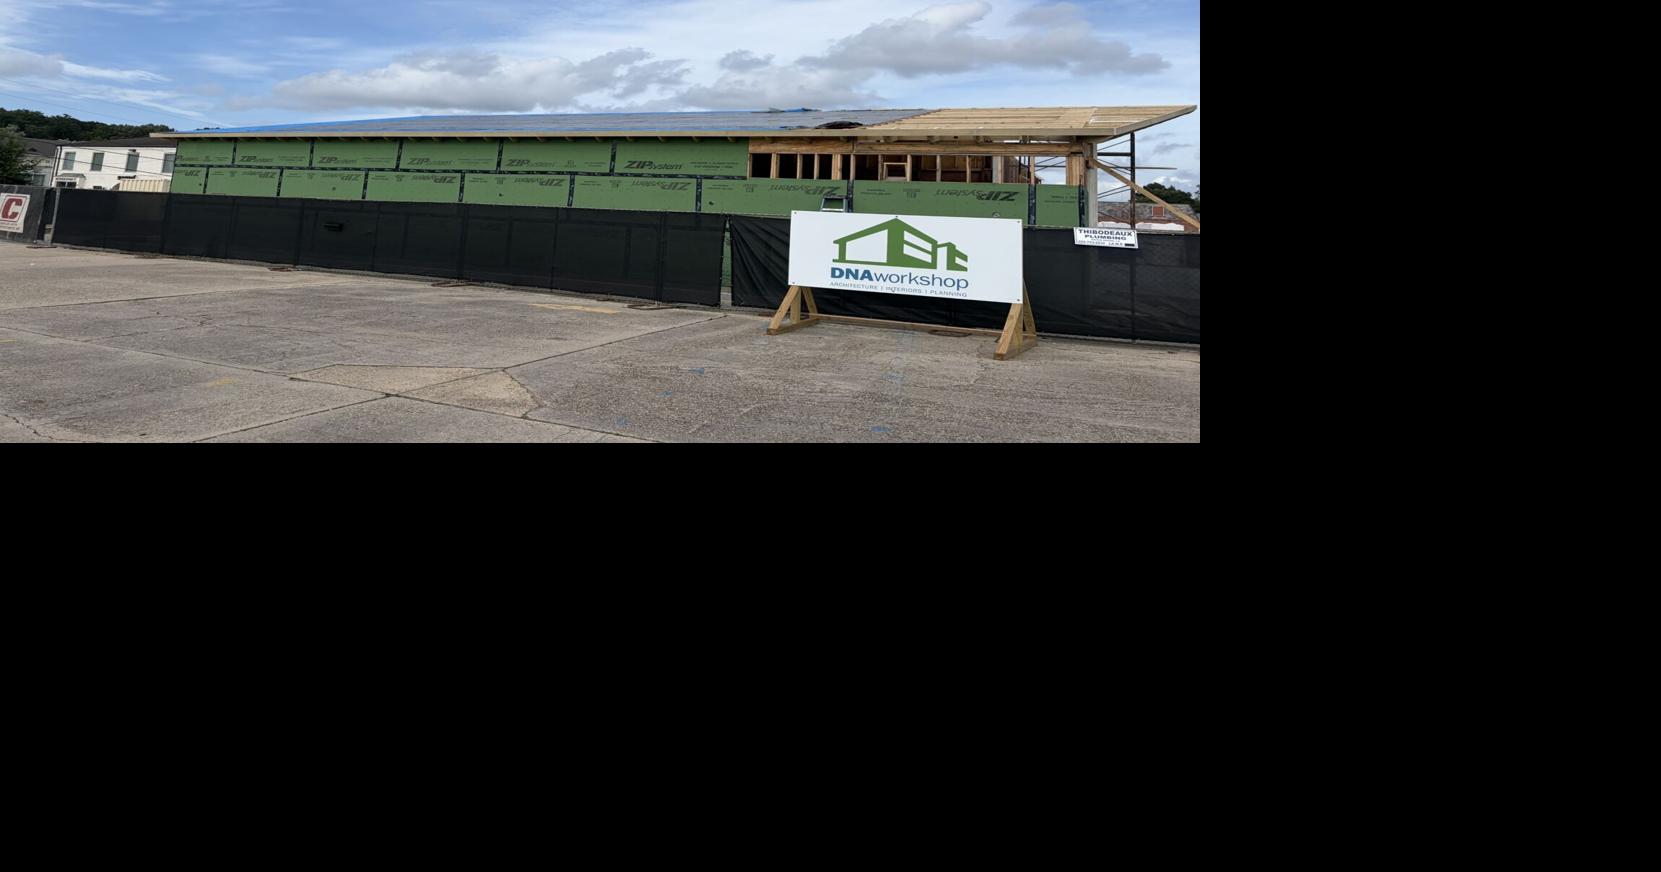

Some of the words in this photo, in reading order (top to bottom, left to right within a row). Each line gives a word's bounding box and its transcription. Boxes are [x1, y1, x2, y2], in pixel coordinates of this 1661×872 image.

[1078, 229, 1133, 237] THIBODEAUX
[830, 281, 878, 291] ARCHITECTURE
[885, 286, 922, 294] INTERIORS
[929, 290, 967, 298] PLANNING
